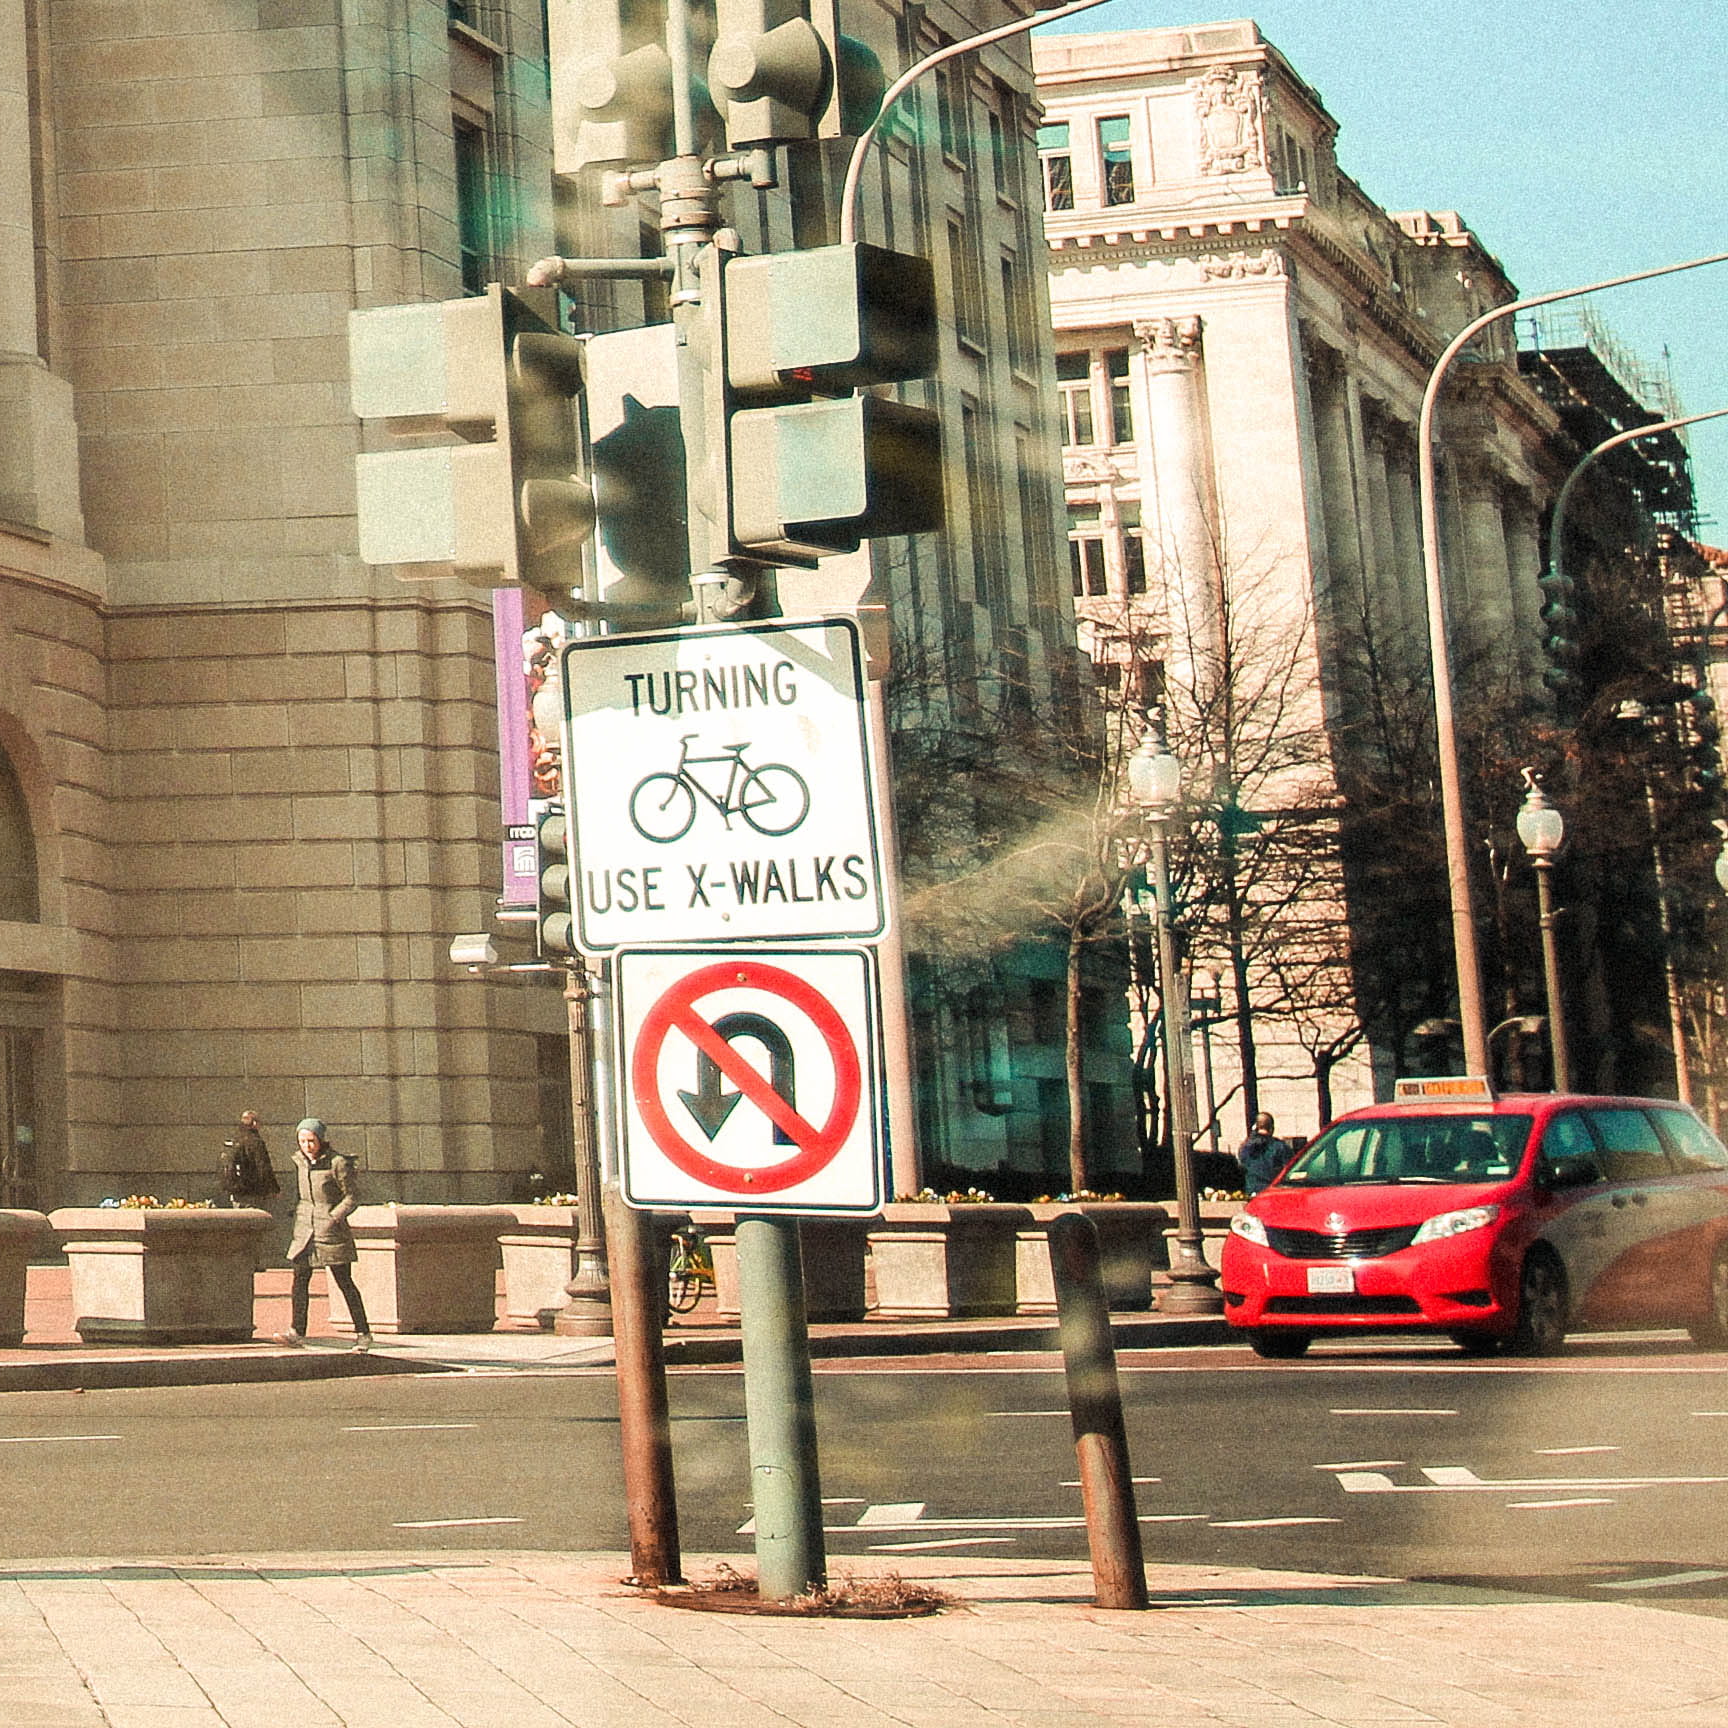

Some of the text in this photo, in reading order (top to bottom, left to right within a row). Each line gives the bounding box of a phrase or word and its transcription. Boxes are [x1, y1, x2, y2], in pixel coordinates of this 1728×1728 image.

[624, 659, 798, 717] TURNING
[588, 854, 869, 914] USE X-WALKS
